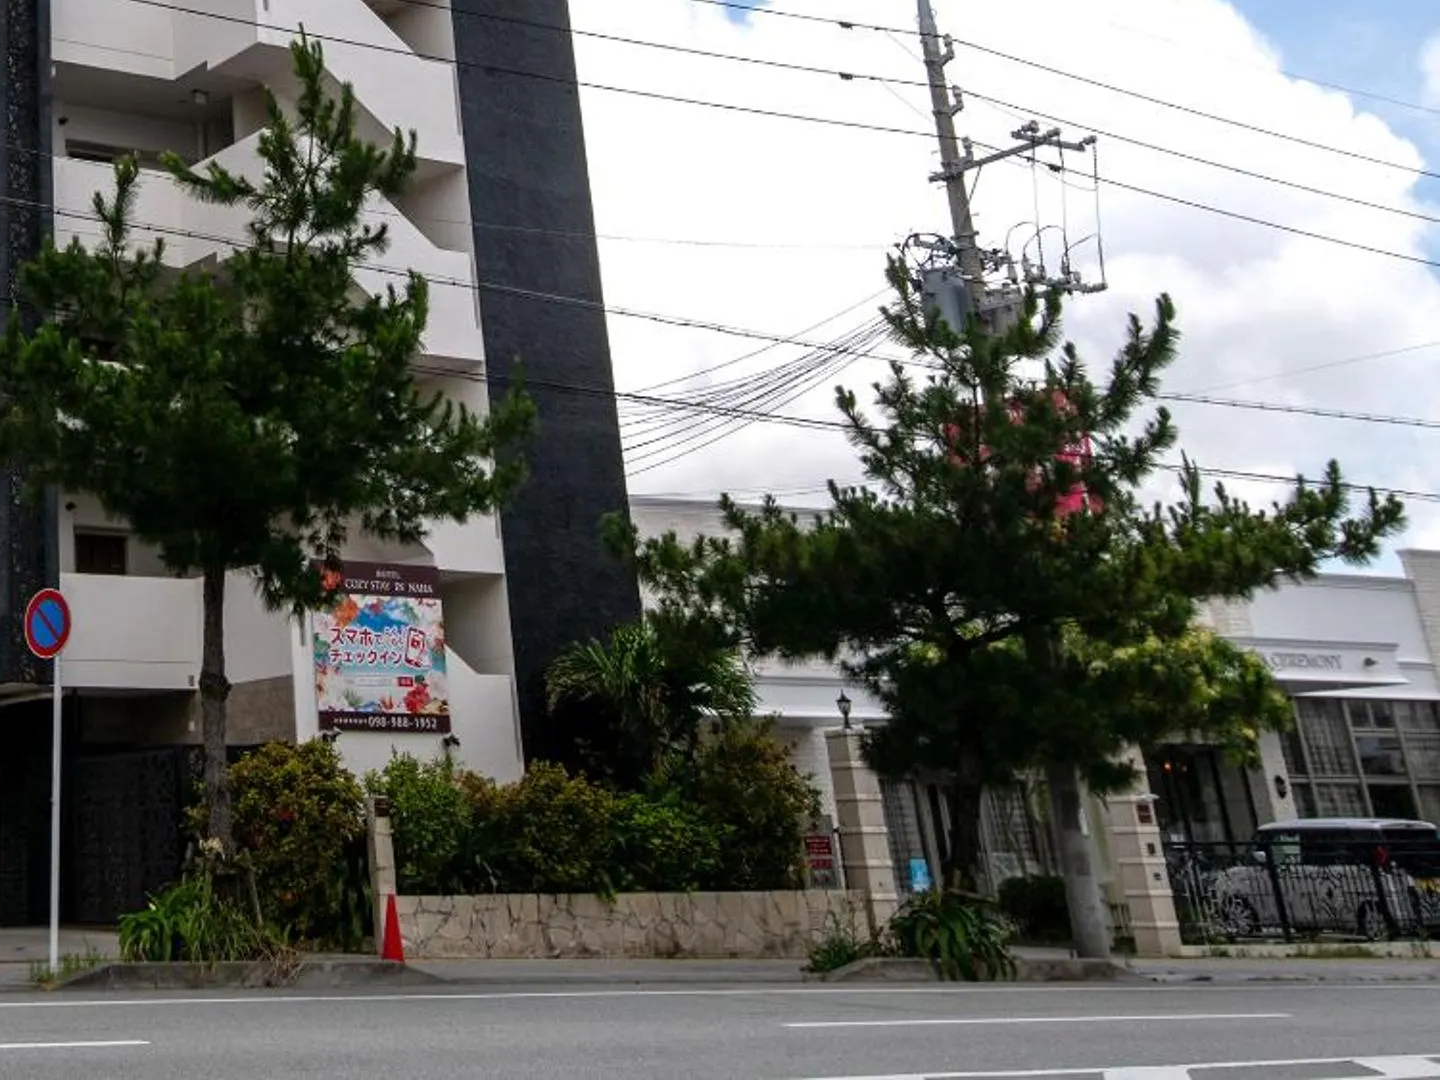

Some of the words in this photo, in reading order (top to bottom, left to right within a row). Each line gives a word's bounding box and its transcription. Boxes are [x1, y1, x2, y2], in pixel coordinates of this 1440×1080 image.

[330, 649, 402, 664] チェックイン
